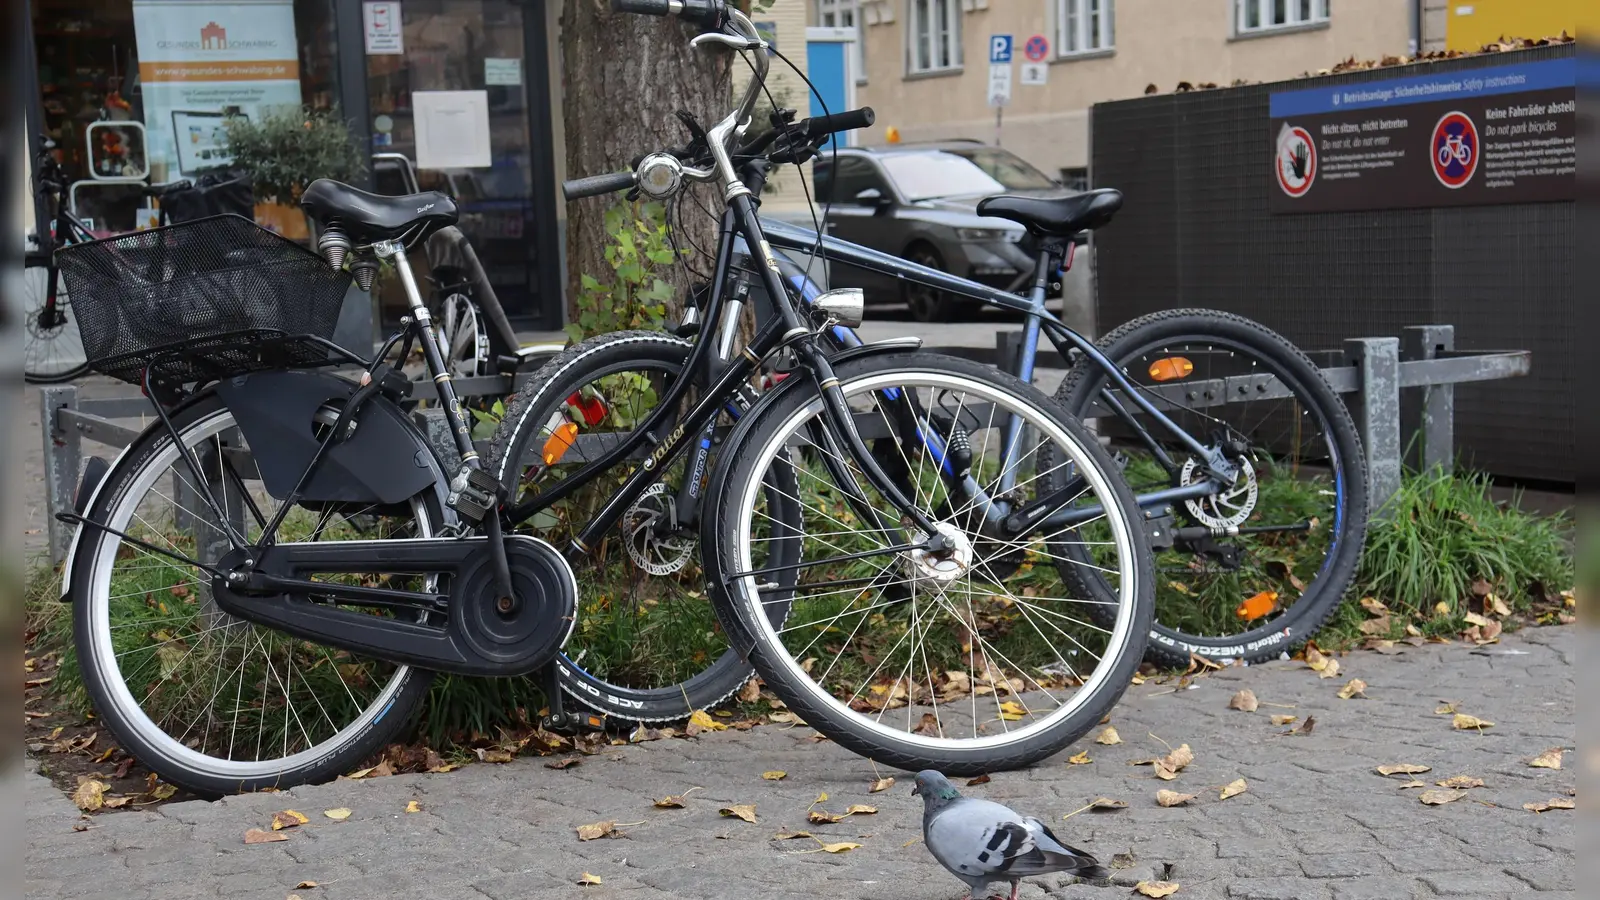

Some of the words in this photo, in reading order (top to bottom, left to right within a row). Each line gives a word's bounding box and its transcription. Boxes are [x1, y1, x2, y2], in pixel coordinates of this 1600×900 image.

[1462, 79, 1485, 92] Safety
[1485, 73, 1527, 88] instructions
[1485, 108, 1507, 120] Keine
[1508, 103, 1546, 118] Fahrräder
[1322, 124, 1339, 134] Nicht
[1340, 123, 1360, 133] sitzen,
[1362, 120, 1379, 132] nicht
[1380, 119, 1408, 130] betreten
[1485, 124, 1496, 136] Do
[1497, 123, 1510, 135] not
[1510, 122, 1528, 137] park
[1528, 119, 1557, 134] bicycles
[1178, 641, 1245, 656] MEZCAL
[576, 680, 600, 697] OF
[608, 695, 643, 709] ACE
[316, 753, 336, 768] PLUS
